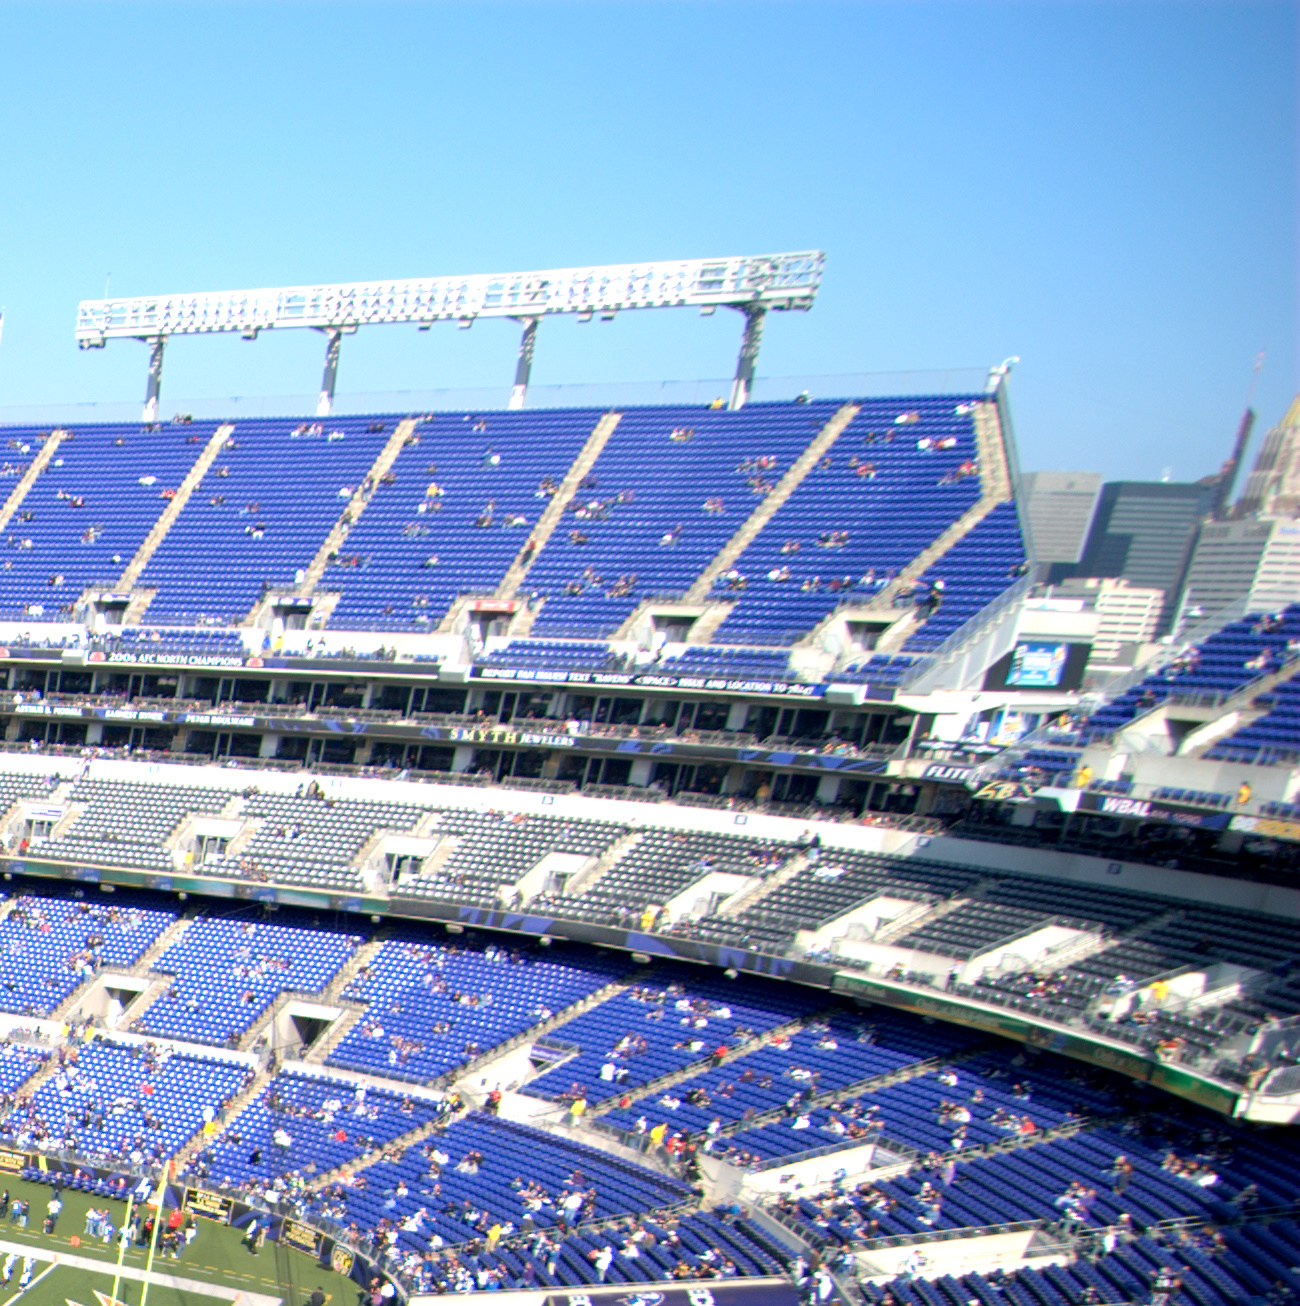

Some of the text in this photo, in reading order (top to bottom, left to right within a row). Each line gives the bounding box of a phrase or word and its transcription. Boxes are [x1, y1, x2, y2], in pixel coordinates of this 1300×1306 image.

[109, 652, 243, 667] 2006 AFC NORTH CHAMPIONS
[481, 668, 516, 679] REPORT
[568, 673, 590, 683] TEXT
[635, 676, 678, 686] <SPACE>
[705, 680, 727, 689] AND
[727, 681, 771, 692] LOCATION
[773, 683, 787, 693] TO
[185, 714, 209, 724] PETER
[451, 729, 575, 747] SMYTH JEWELERS
[1101, 797, 1151, 818] WBAL
